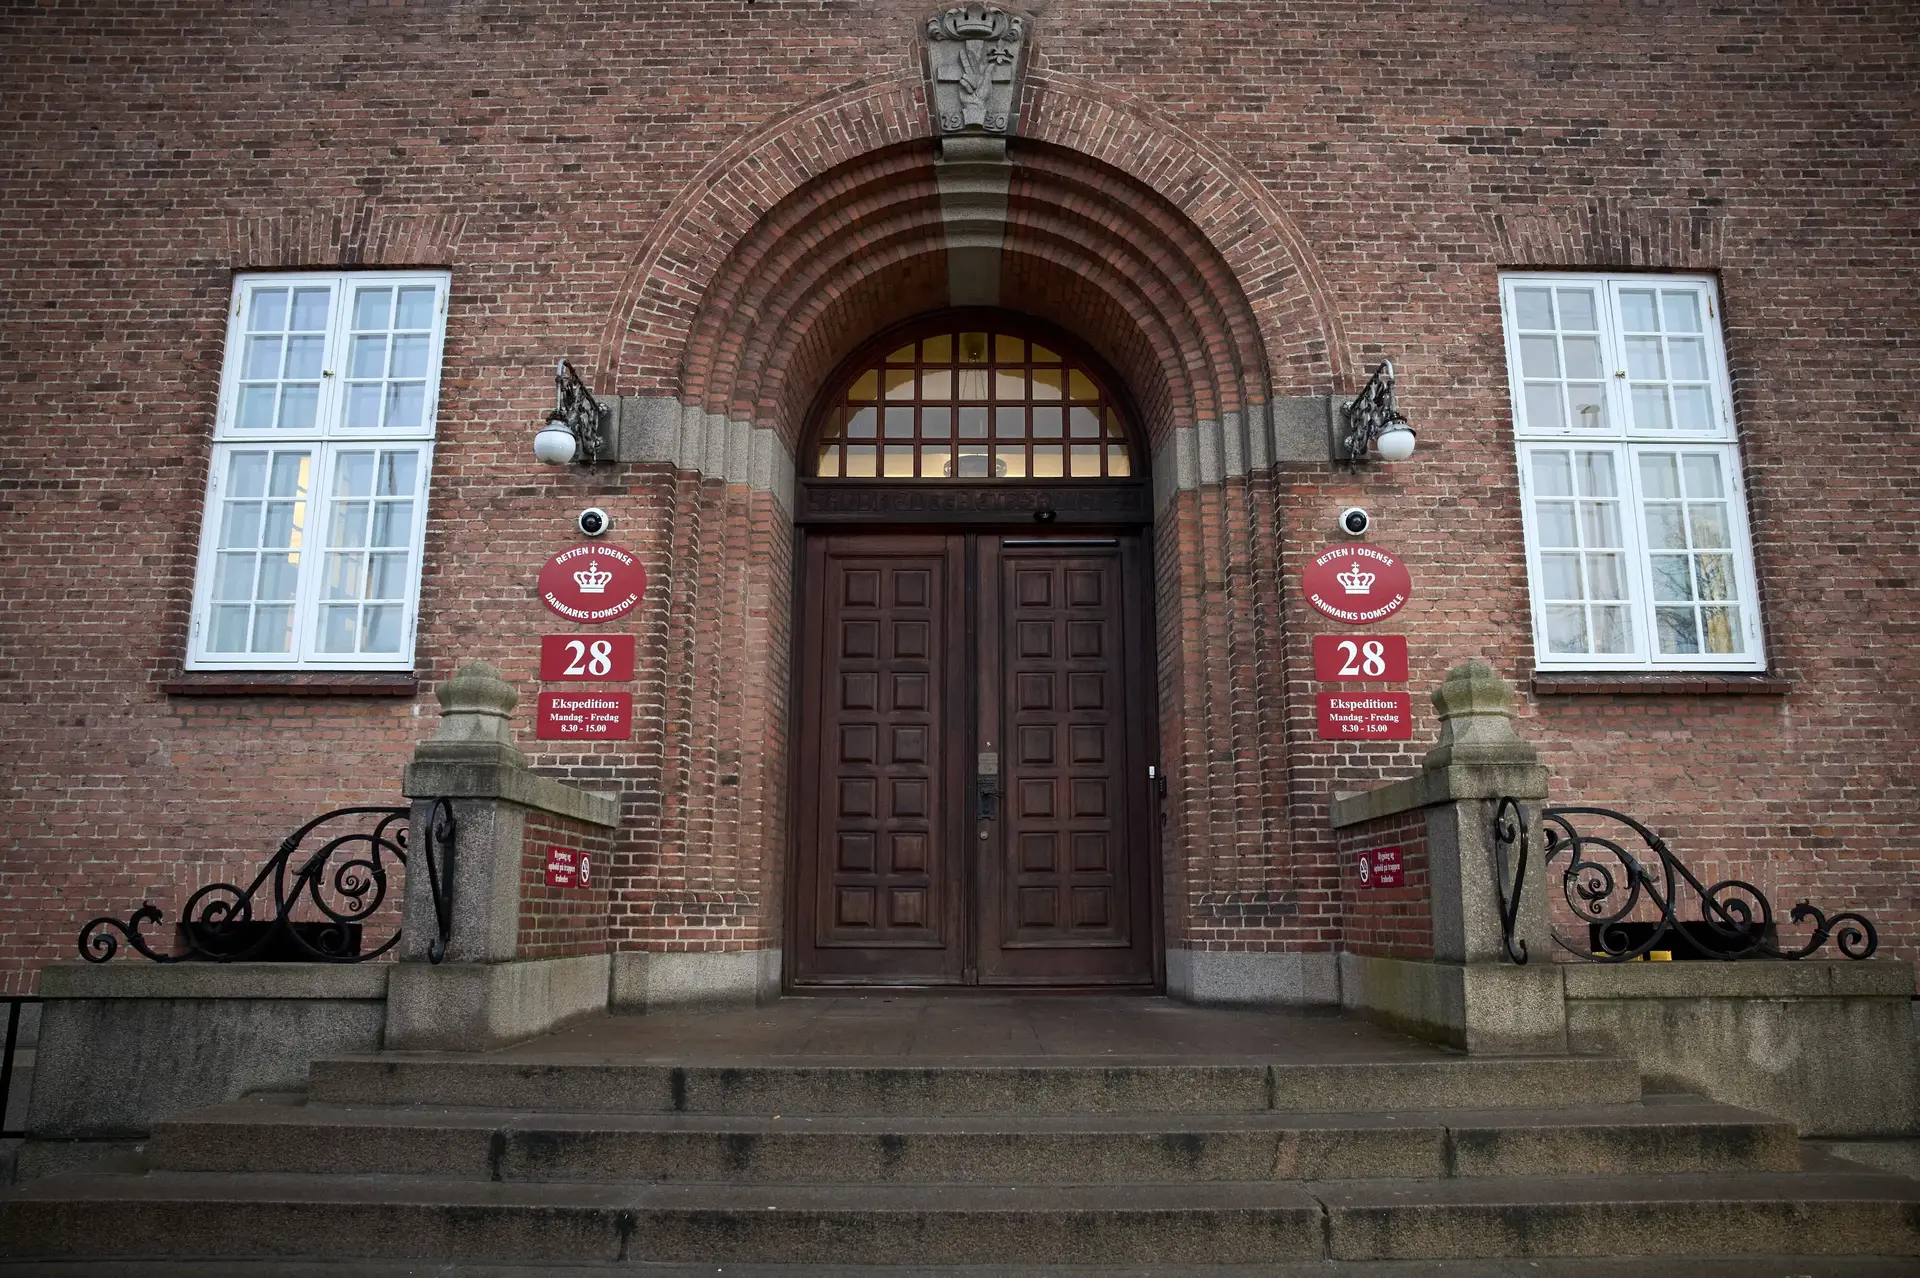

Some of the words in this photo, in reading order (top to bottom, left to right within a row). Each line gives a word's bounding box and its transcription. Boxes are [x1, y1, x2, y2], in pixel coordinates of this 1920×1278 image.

[941, 115, 961, 129] 19
[985, 115, 1005, 130] 20
[555, 546, 589, 565] RETTEN
[591, 546, 595, 554] I
[598, 546, 633, 566] ODENSE
[1316, 548, 1349, 567] RETTEN
[1357, 548, 1394, 567] ODENSE
[544, 592, 589, 619] DANMARKS
[591, 592, 638, 619] DOMSTOLE
[1311, 593, 1358, 620] DANMARKS
[1360, 593, 1404, 620] DOMSTOLE
[562, 639, 612, 676] 28
[1337, 640, 1386, 676] 28
[552, 698, 619, 711] Ekspedition:
[1330, 698, 1398, 711] Ekspedition:
[550, 713, 583, 723] Mandag
[591, 713, 619, 723] Fredag
[1329, 713, 1363, 723] Mandag
[1370, 713, 1399, 723] Fredag
[561, 724, 578, 732] 8.30
[585, 724, 607, 732] 15.00
[1341, 724, 1359, 732] 8.30
[1366, 724, 1388, 732] 15.00
